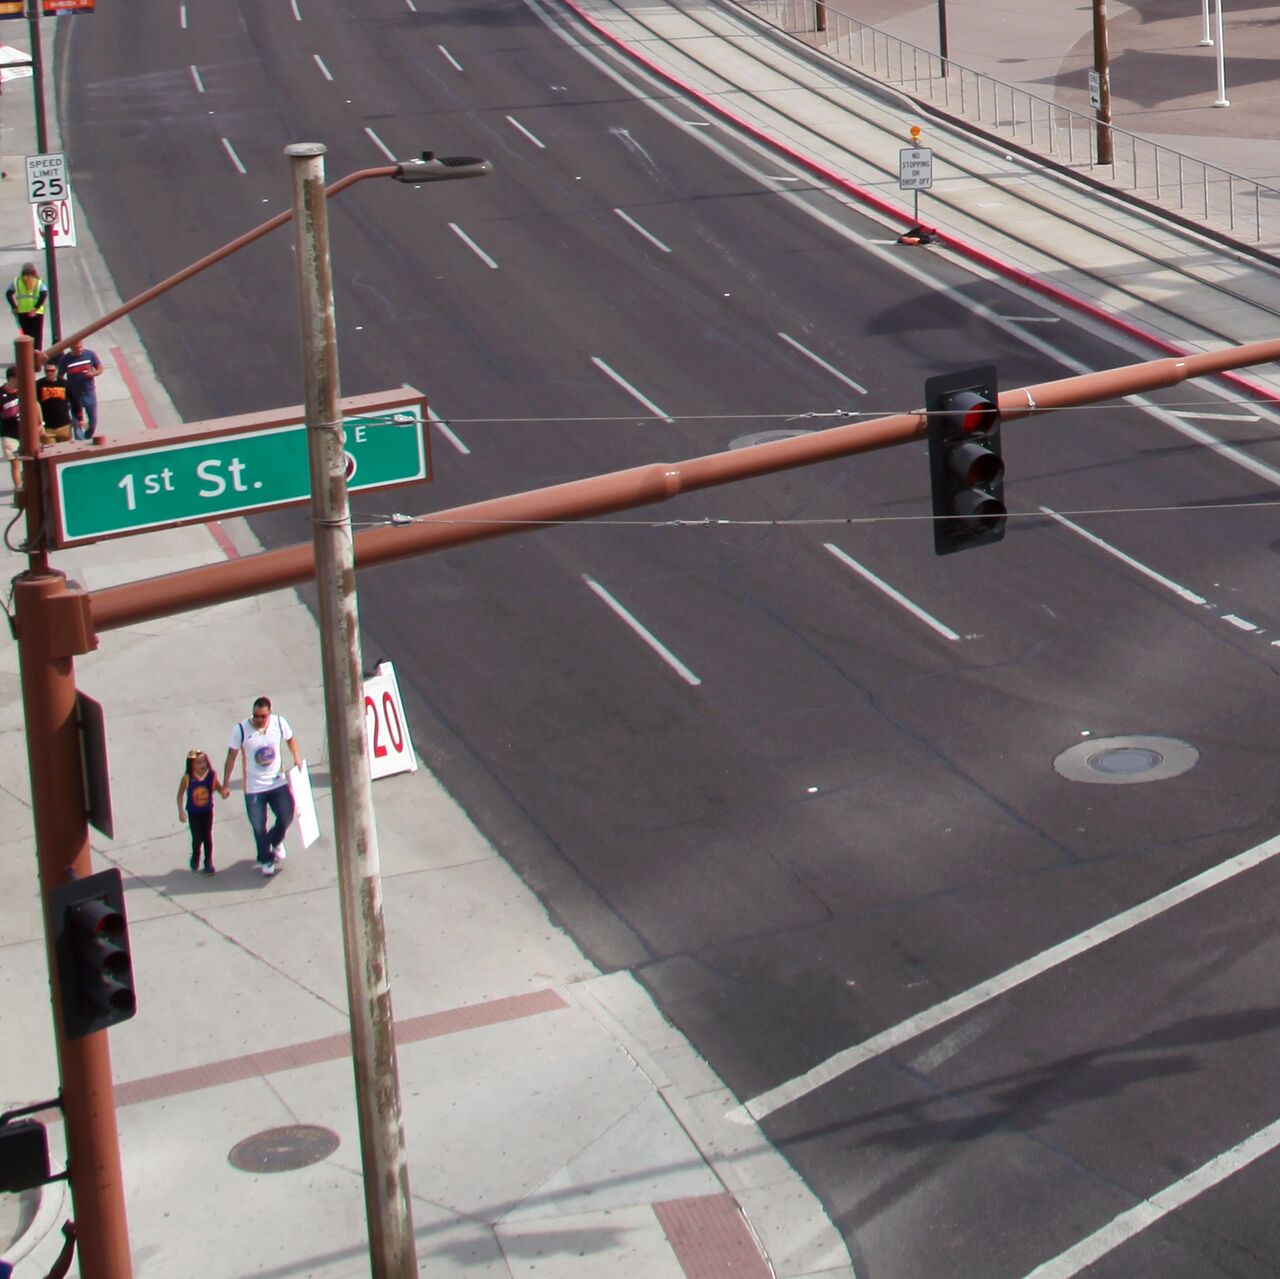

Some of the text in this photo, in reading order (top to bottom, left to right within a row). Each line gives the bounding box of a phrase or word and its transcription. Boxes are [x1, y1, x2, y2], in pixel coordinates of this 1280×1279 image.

[29, 158, 62, 169] SPEED
[33, 169, 59, 178] LIMIT
[31, 178, 63, 197] 25
[354, 425, 367, 443] E
[117, 457, 263, 511] 1st St.
[364, 691, 403, 758] 20
